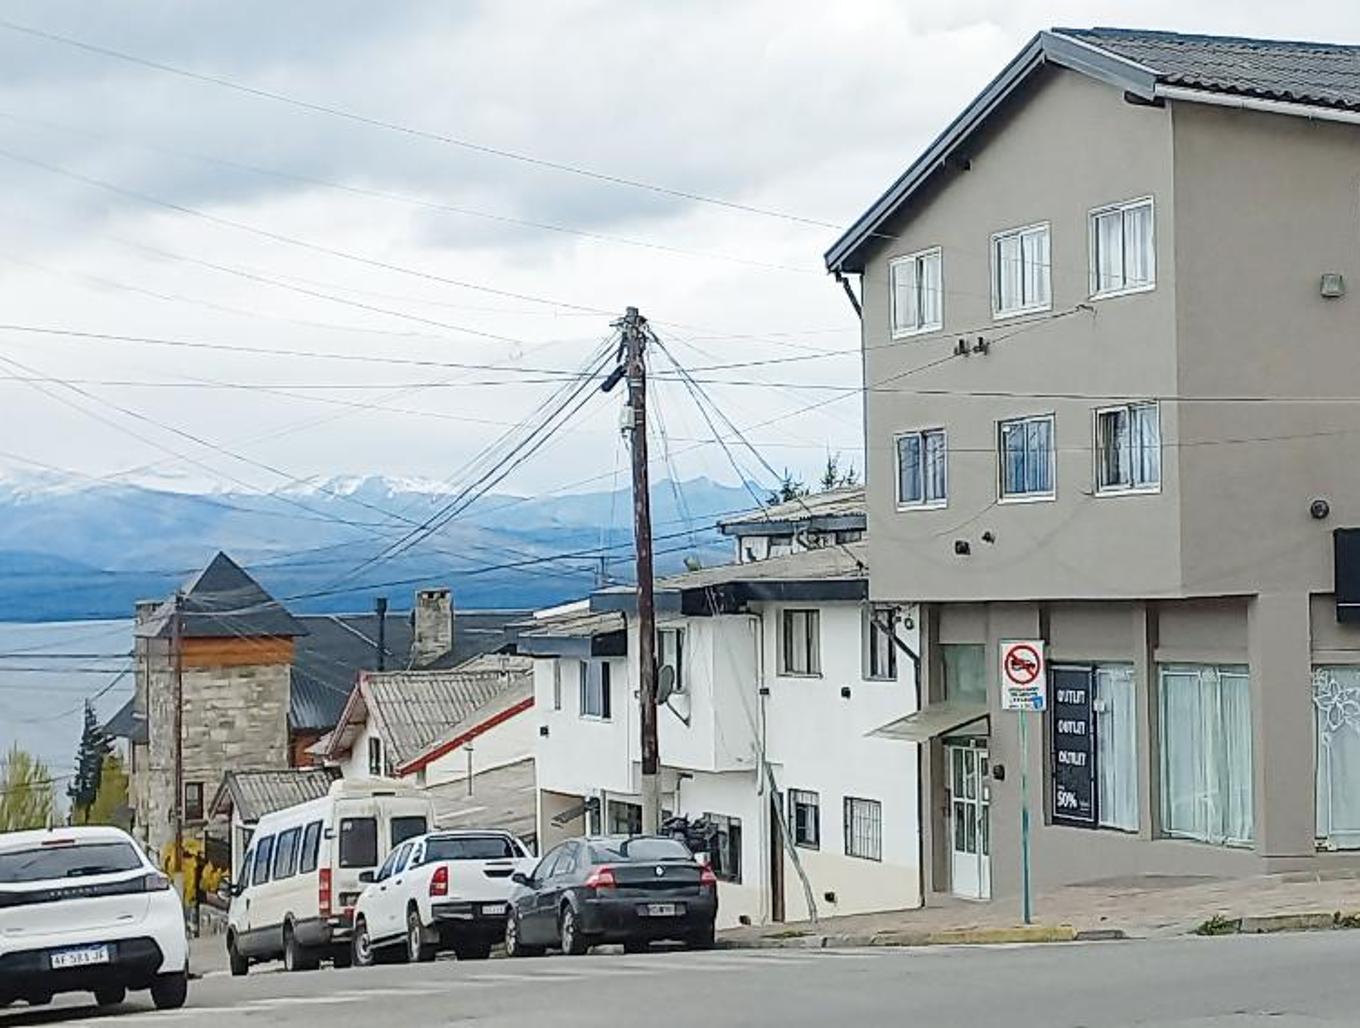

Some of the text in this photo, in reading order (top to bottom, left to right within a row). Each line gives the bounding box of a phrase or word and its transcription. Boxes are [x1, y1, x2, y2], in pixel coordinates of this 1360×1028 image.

[1057, 690, 1085, 704] OUTLET
[1057, 720, 1086, 735] OUTLET
[1058, 750, 1087, 766] OUTLET
[1057, 790, 1077, 808] 50%
